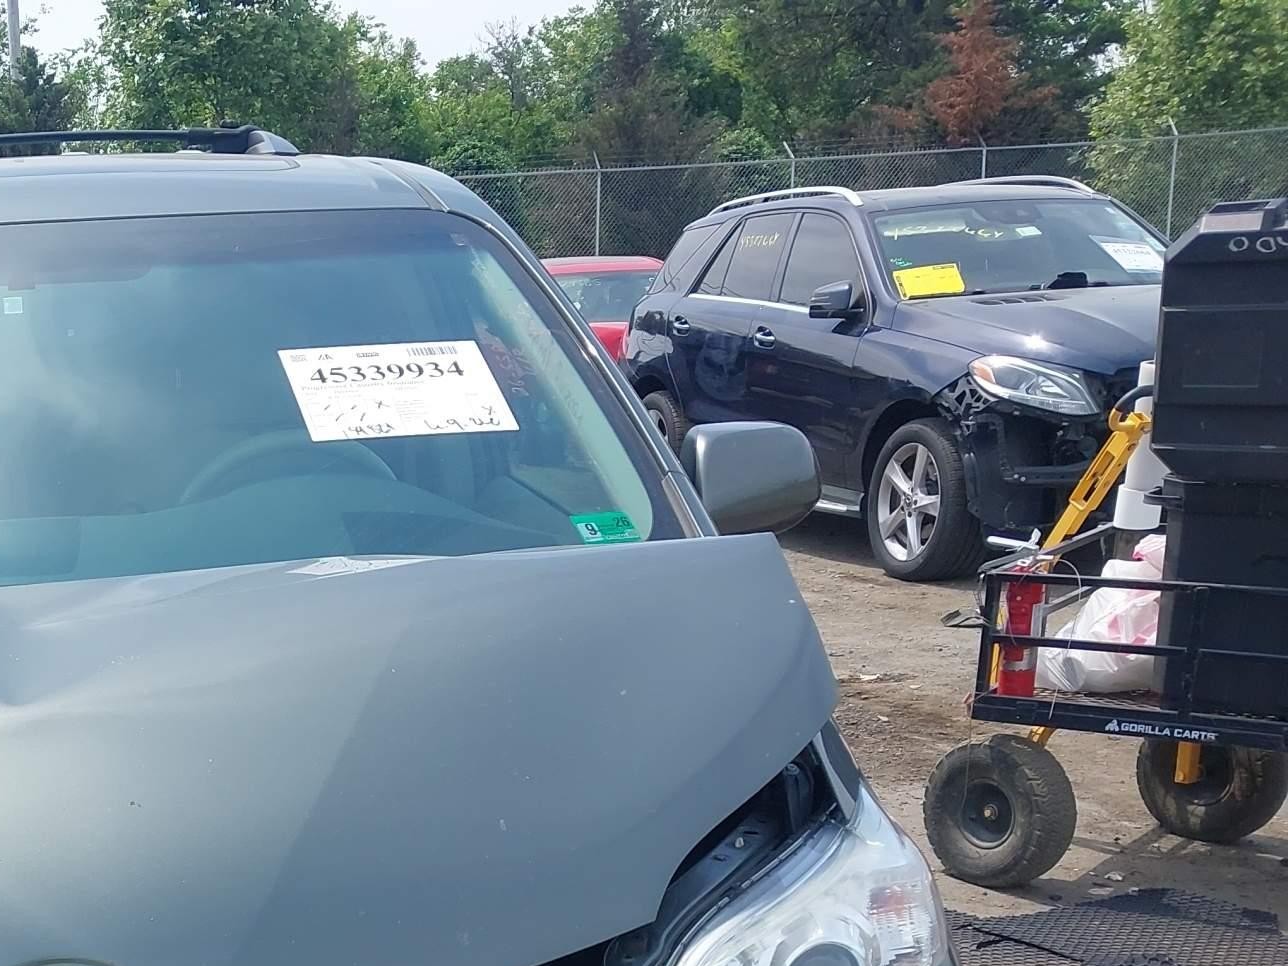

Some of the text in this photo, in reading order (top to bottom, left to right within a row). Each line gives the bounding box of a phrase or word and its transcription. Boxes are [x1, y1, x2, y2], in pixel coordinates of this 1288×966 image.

[309, 360, 465, 384] 45339934
[584, 523, 597, 536] 9
[1120, 722, 1217, 741] GORILLA CARTS
